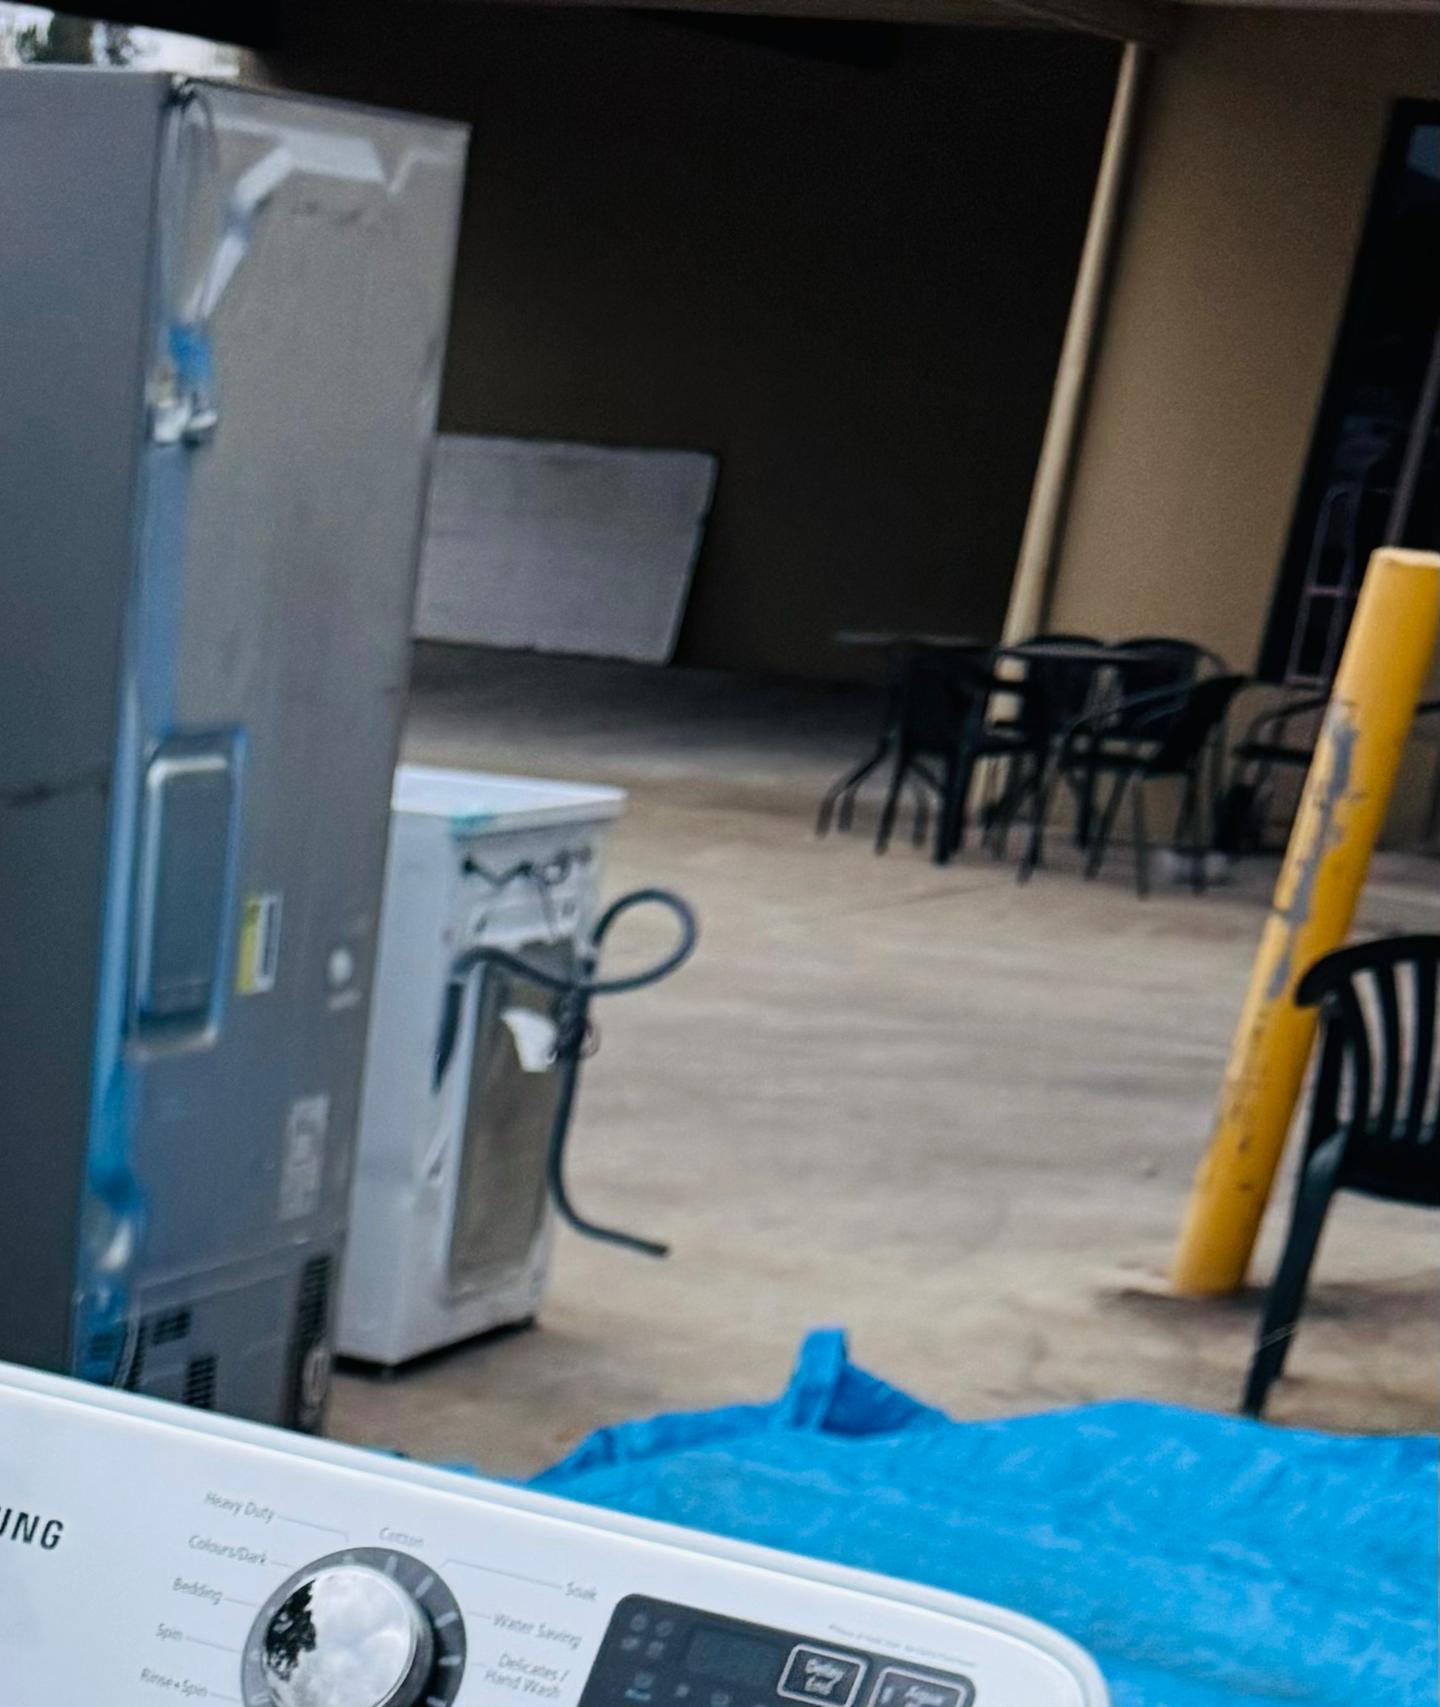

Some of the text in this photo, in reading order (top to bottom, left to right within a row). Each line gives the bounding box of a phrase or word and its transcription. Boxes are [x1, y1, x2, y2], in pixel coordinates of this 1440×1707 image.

[205, 1492, 276, 1523] Heavy Duty
[378, 1527, 425, 1548] Cotton
[172, 1577, 223, 1605] Bedding
[565, 1581, 597, 1601] Soak
[155, 1622, 183, 1643] Spin
[493, 1613, 583, 1650] Water Saving
[485, 1669, 562, 1699] Hand Wash
